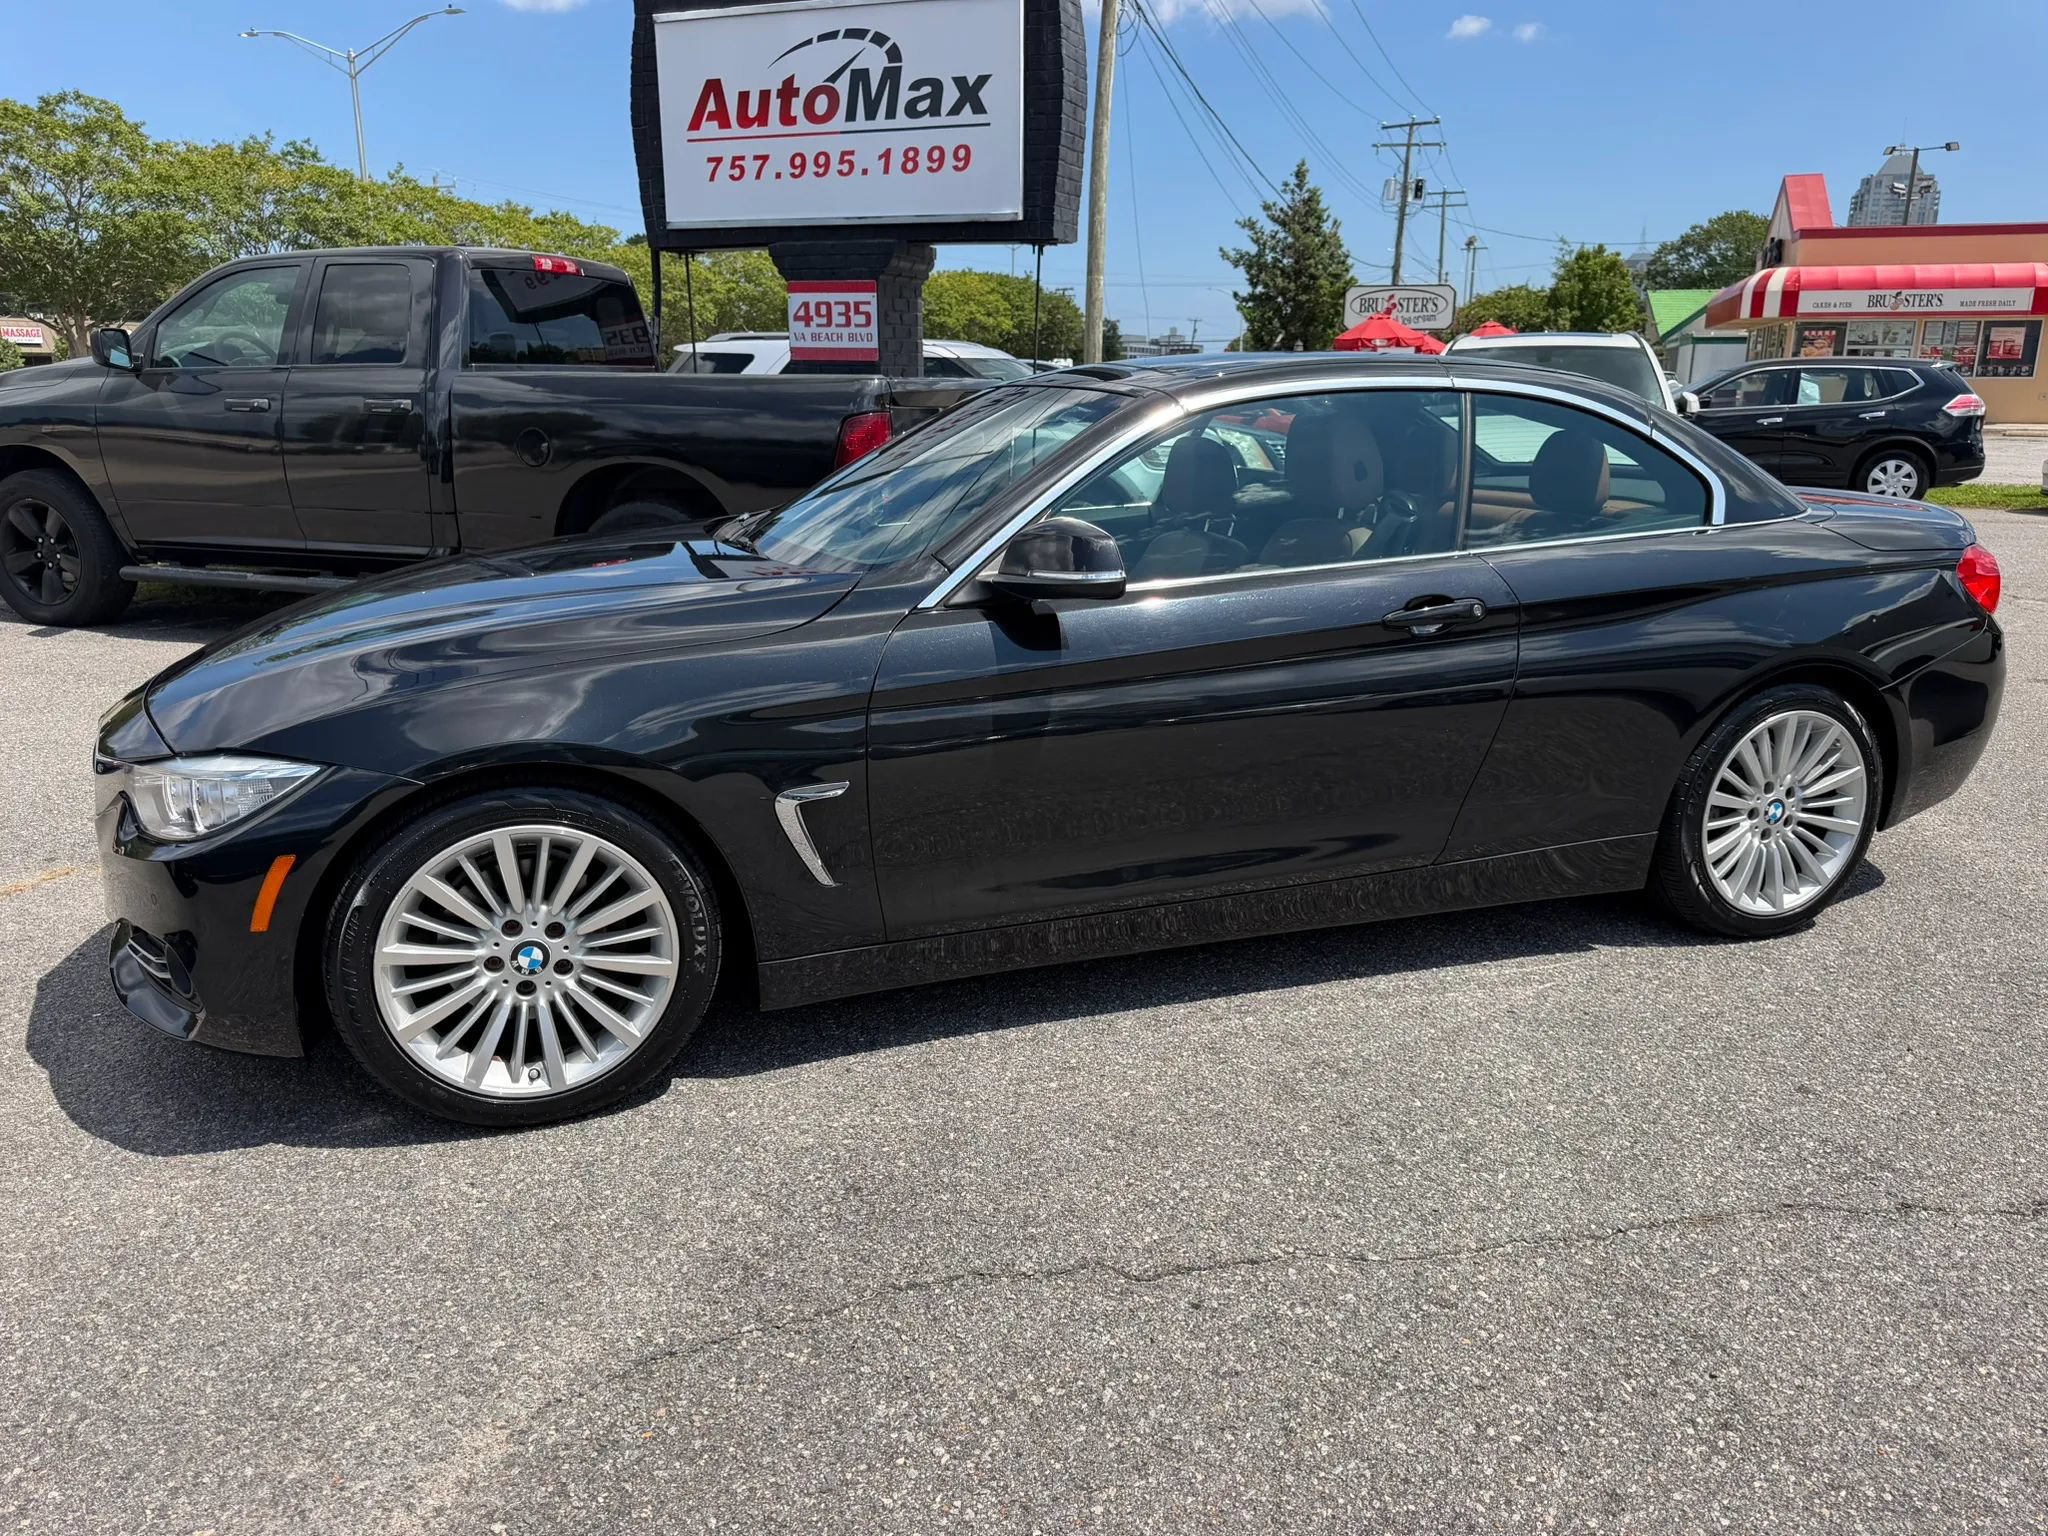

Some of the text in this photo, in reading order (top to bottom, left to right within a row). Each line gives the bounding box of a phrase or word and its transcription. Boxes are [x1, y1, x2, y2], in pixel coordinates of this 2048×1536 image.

[686, 66, 992, 132] AutoMax
[706, 143, 972, 183] 757.995.1899
[1867, 293, 1943, 308] BRUSTER'S
[1998, 299, 2016, 307] DAILY
[792, 300, 873, 328] 4935
[2, 328, 41, 337] MASSAGE
[793, 332, 873, 342] VA BEACH BLVD
